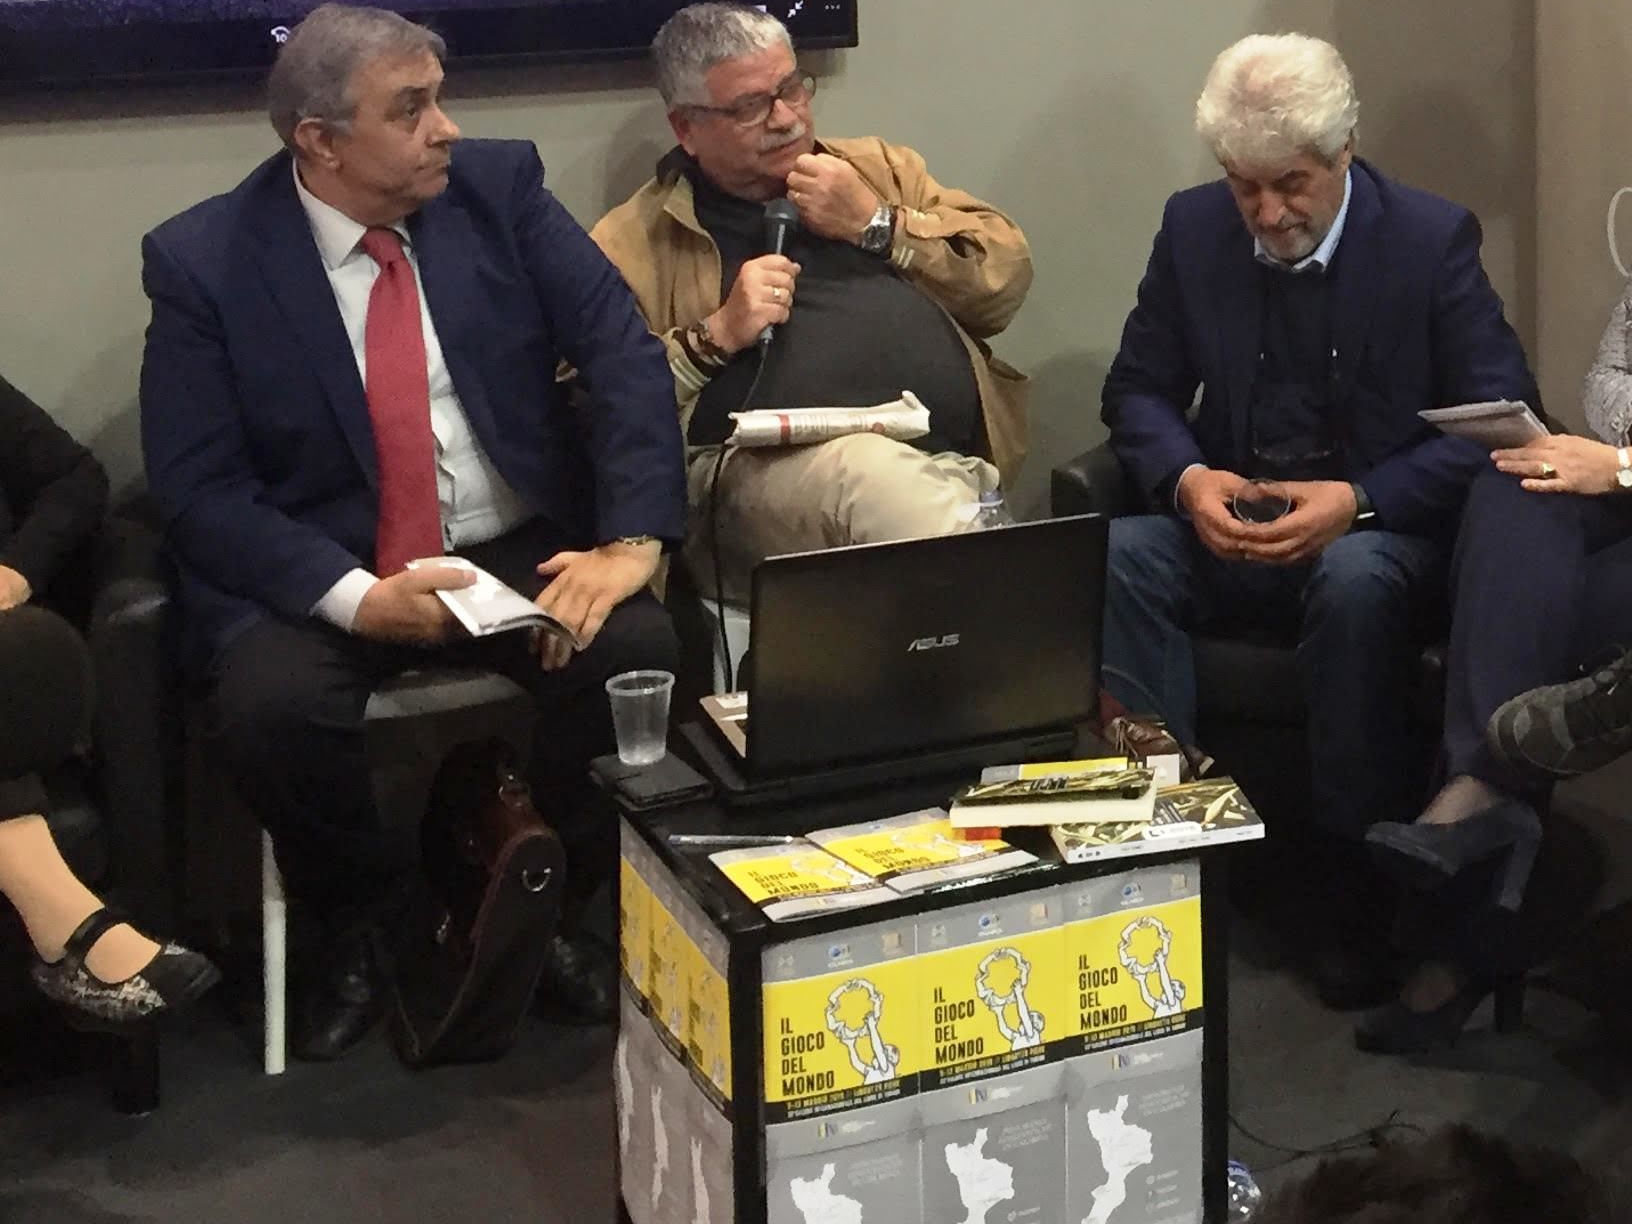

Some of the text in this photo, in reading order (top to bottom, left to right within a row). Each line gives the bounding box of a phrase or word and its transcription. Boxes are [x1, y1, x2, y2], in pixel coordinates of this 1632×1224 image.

[907, 633, 960, 652] ASUS
[1079, 954, 1089, 970] IL
[1079, 967, 1118, 990] GIOCO
[934, 987, 945, 1003] IL
[1080, 992, 1101, 1009] DEL
[934, 999, 975, 1024] GIOCO
[1080, 1005, 1127, 1030] MONDO
[780, 1018, 793, 1034] IL
[935, 1025, 957, 1043] DEL
[781, 1031, 824, 1055] GIOCO
[935, 1037, 984, 1064] MONDO
[782, 1057, 806, 1075] DEL
[782, 1070, 834, 1096] MONDO
